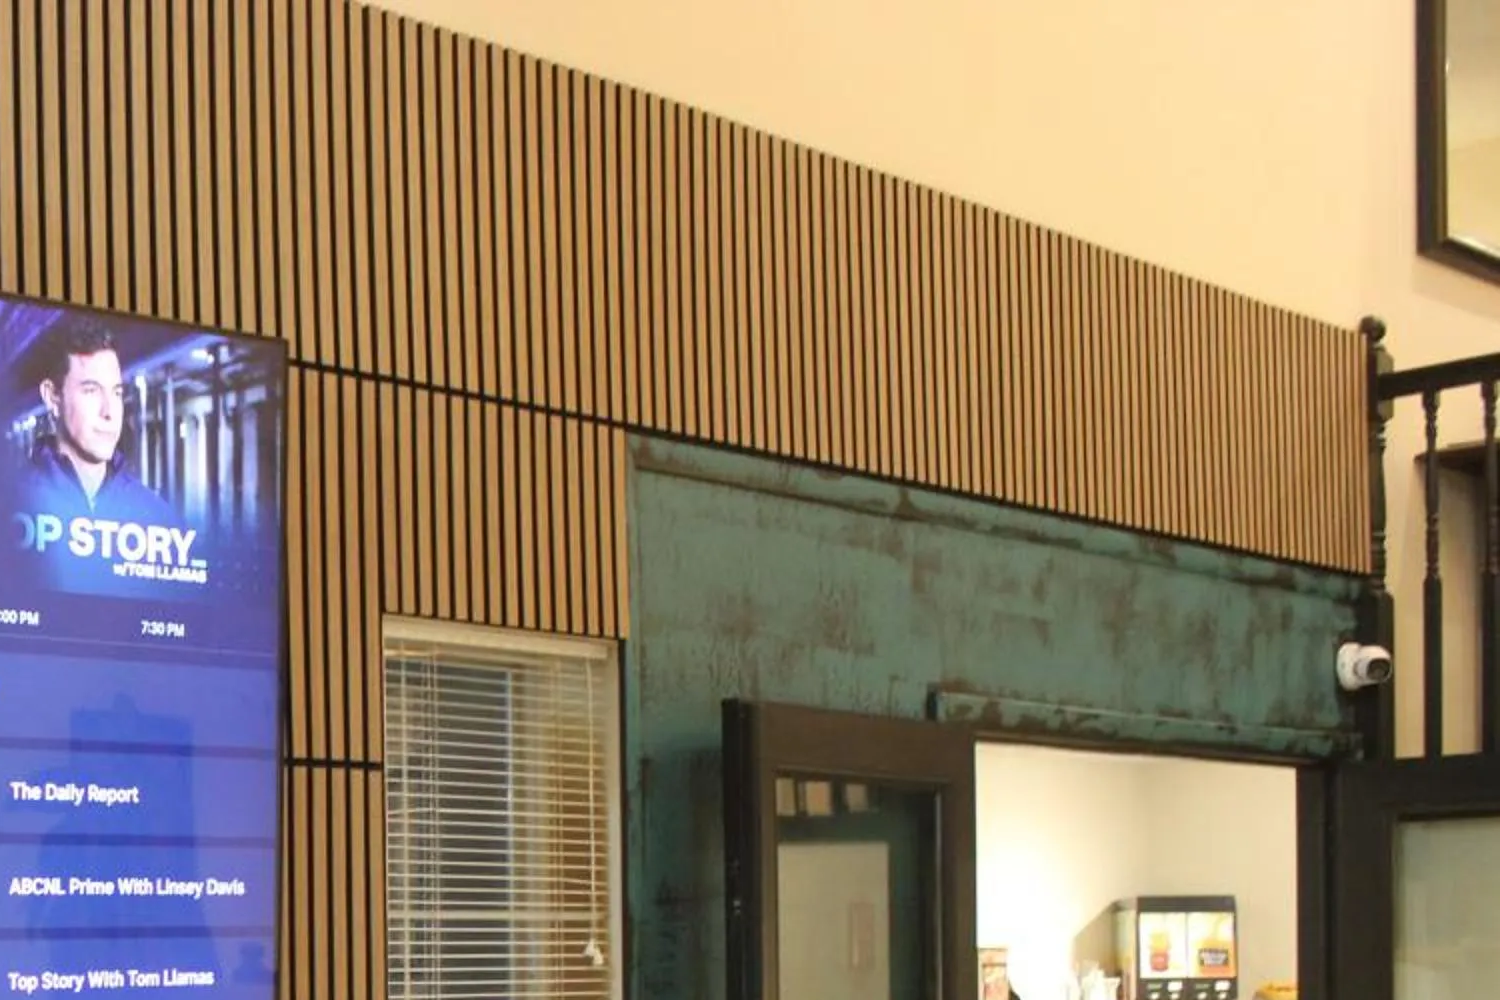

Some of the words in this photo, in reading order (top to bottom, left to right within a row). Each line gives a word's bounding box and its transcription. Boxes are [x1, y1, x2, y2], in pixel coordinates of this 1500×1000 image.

[18, 609, 40, 627] PM
[166, 622, 185, 639] PM
[9, 781, 43, 803] The
[45, 783, 86, 807] Daily
[87, 784, 141, 808] Report
[8, 877, 66, 898] ABCNL
[68, 877, 115, 898] Prime
[116, 877, 154, 897] With
[155, 877, 204, 901] Linsey
[205, 877, 246, 898] Davis
[7, 970, 39, 994] Top
[40, 969, 86, 992] Story
[87, 968, 126, 990] With
[127, 967, 161, 989] Tom
[162, 967, 216, 989] Llamas
